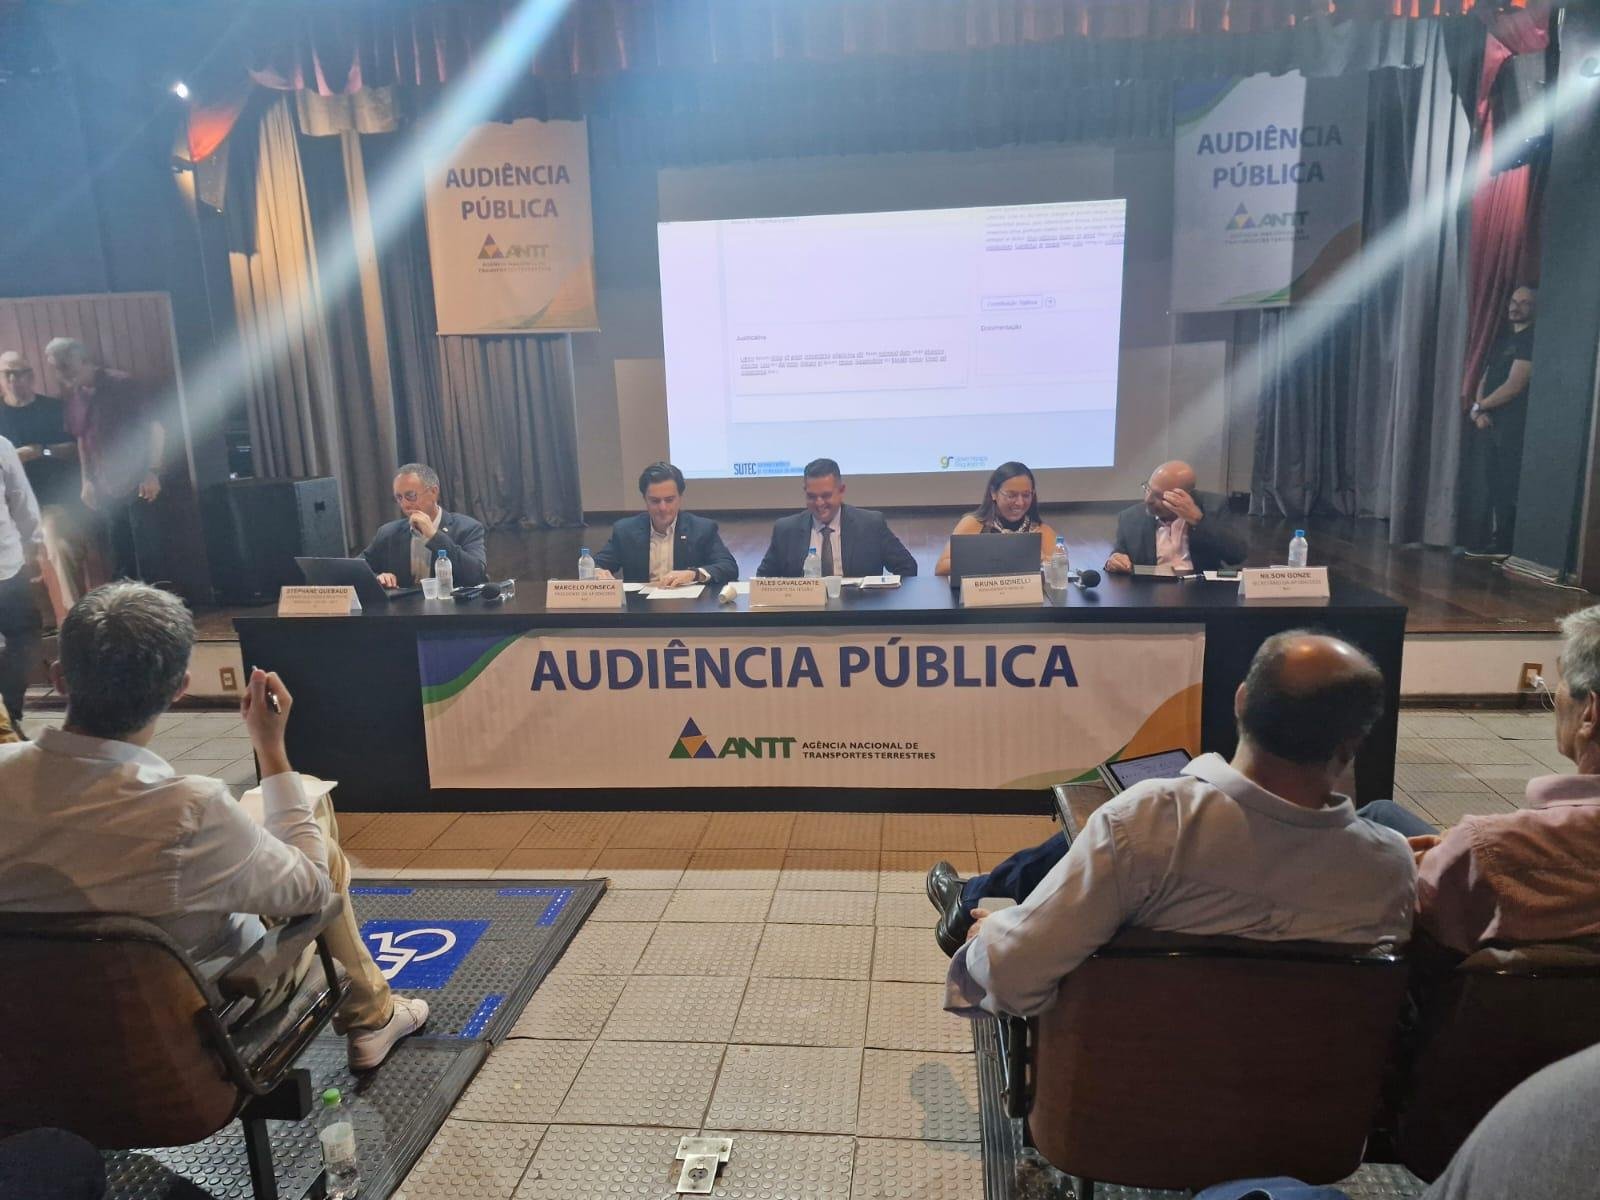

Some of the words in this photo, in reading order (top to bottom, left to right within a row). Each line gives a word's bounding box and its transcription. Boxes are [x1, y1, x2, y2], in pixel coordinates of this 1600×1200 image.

[1197, 124, 1342, 156] AUDIÊNCIA
[446, 162, 570, 188] AUDIÊNCIA
[1213, 161, 1324, 189] PÚBLICA
[461, 195, 559, 220] PÚBLICA
[1257, 210, 1310, 228] ANTT
[505, 244, 550, 259] ANTT
[733, 462, 757, 475] SUTEC
[531, 639, 824, 691] AUDIÊNCIA
[839, 637, 1079, 688] PÚBLICA
[717, 737, 798, 759] ANTT
[802, 740, 847, 750] AGÊNCIA
[849, 742, 902, 750] NACIONAL
[905, 742, 919, 750] DE
[803, 752, 874, 760] TRANSPORTES
[874, 752, 936, 760] TERRESTRES
